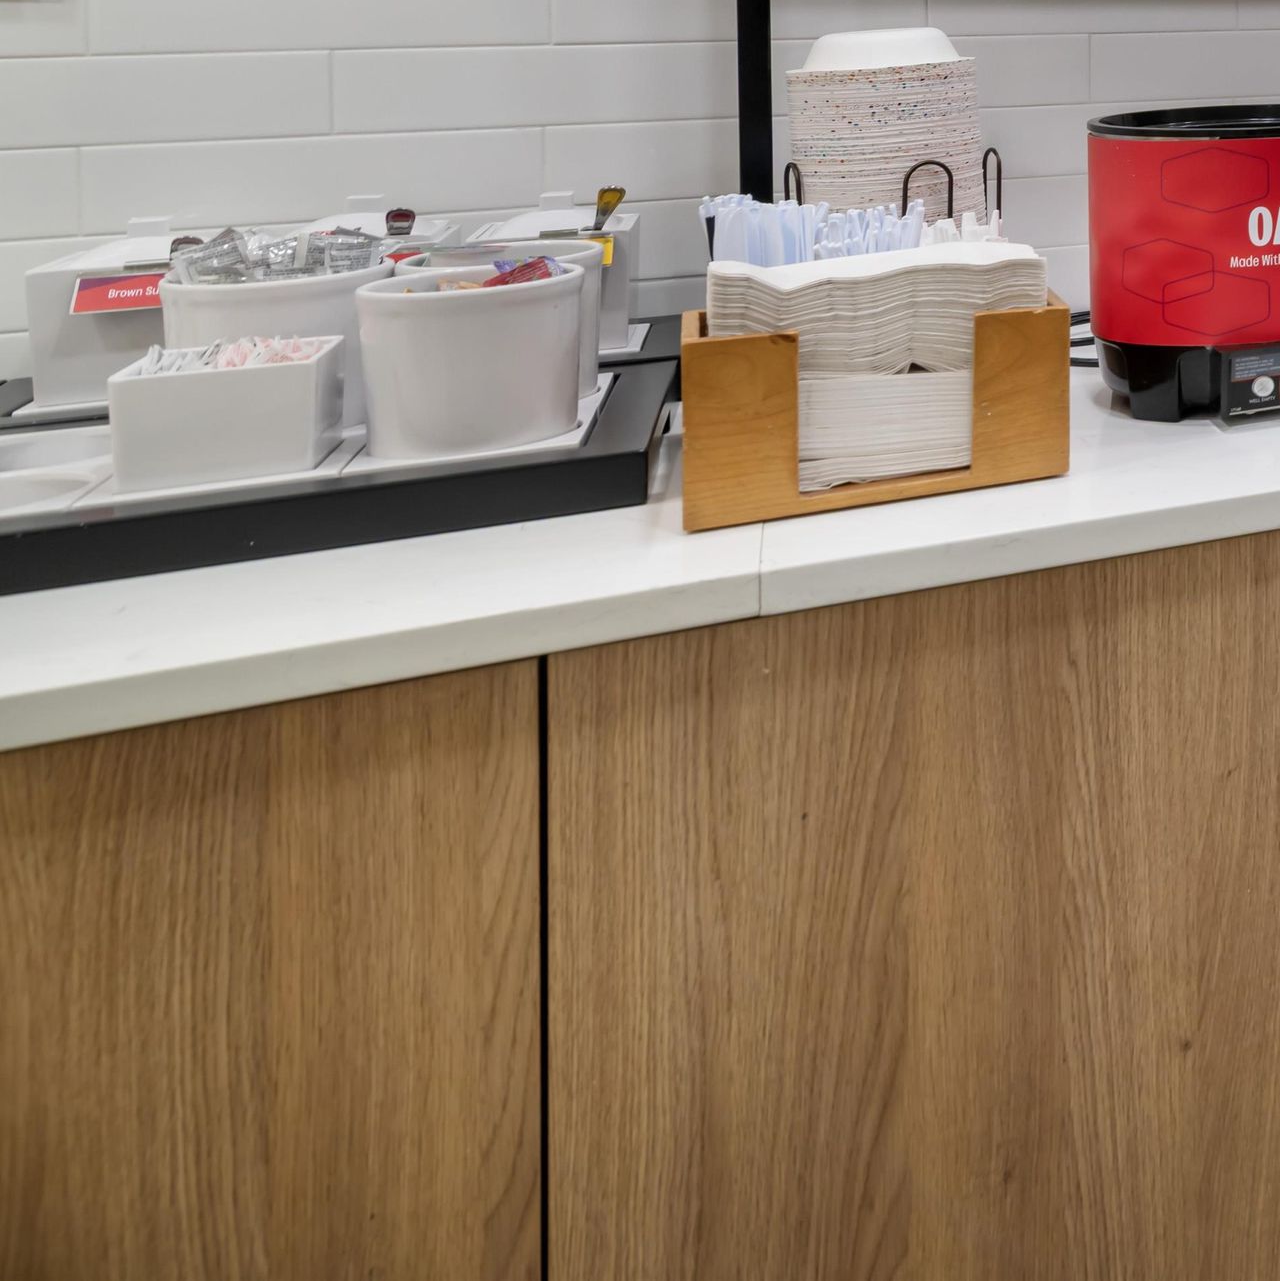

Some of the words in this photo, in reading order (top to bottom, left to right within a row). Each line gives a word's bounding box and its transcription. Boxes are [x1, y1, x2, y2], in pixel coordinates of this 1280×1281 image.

[1230, 256, 1259, 268] Made
[108, 288, 143, 299] Brown
[145, 286, 160, 296] Su
